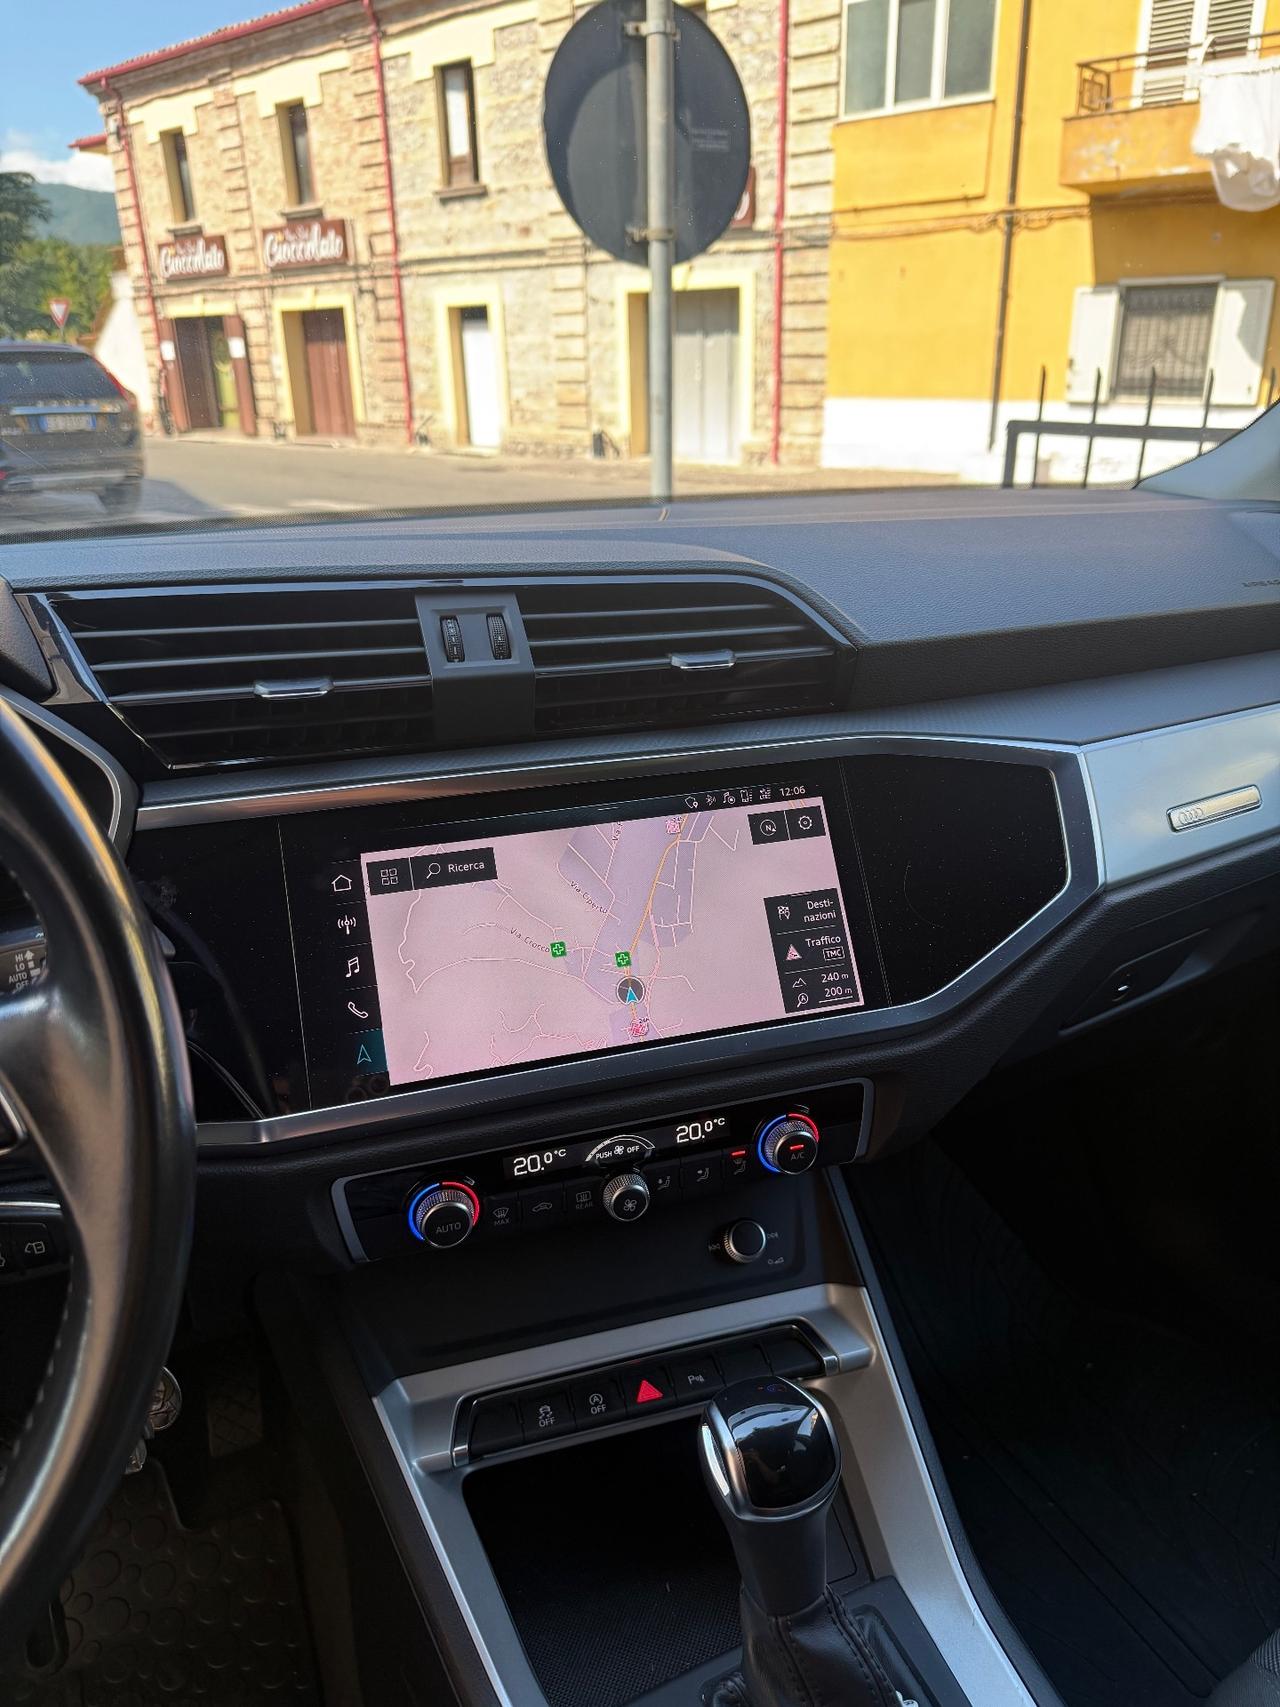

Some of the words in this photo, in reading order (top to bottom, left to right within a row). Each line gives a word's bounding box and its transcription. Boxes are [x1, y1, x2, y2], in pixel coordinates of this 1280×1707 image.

[780, 786, 806, 797] 12:06
[448, 861, 485, 873] Ricerca
[571, 881, 581, 893] Via
[807, 899, 834, 910] Desti-
[804, 910, 836, 923] nazioni
[510, 928, 522, 939] Via
[805, 936, 841, 947] Traffico
[15, 953, 24, 962] HI
[825, 949, 842, 958] TMC
[15, 962, 26, 972] LO
[9, 971, 28, 984] AUTO
[821, 972, 840, 983] 240
[825, 986, 843, 998] 200
[595, 1151, 613, 1160] PUSH
[627, 1145, 640, 1154] OFF
[435, 1221, 462, 1234] AUTO
[590, 1404, 607, 1415] OFF
[538, 1417, 556, 1427] OFF
